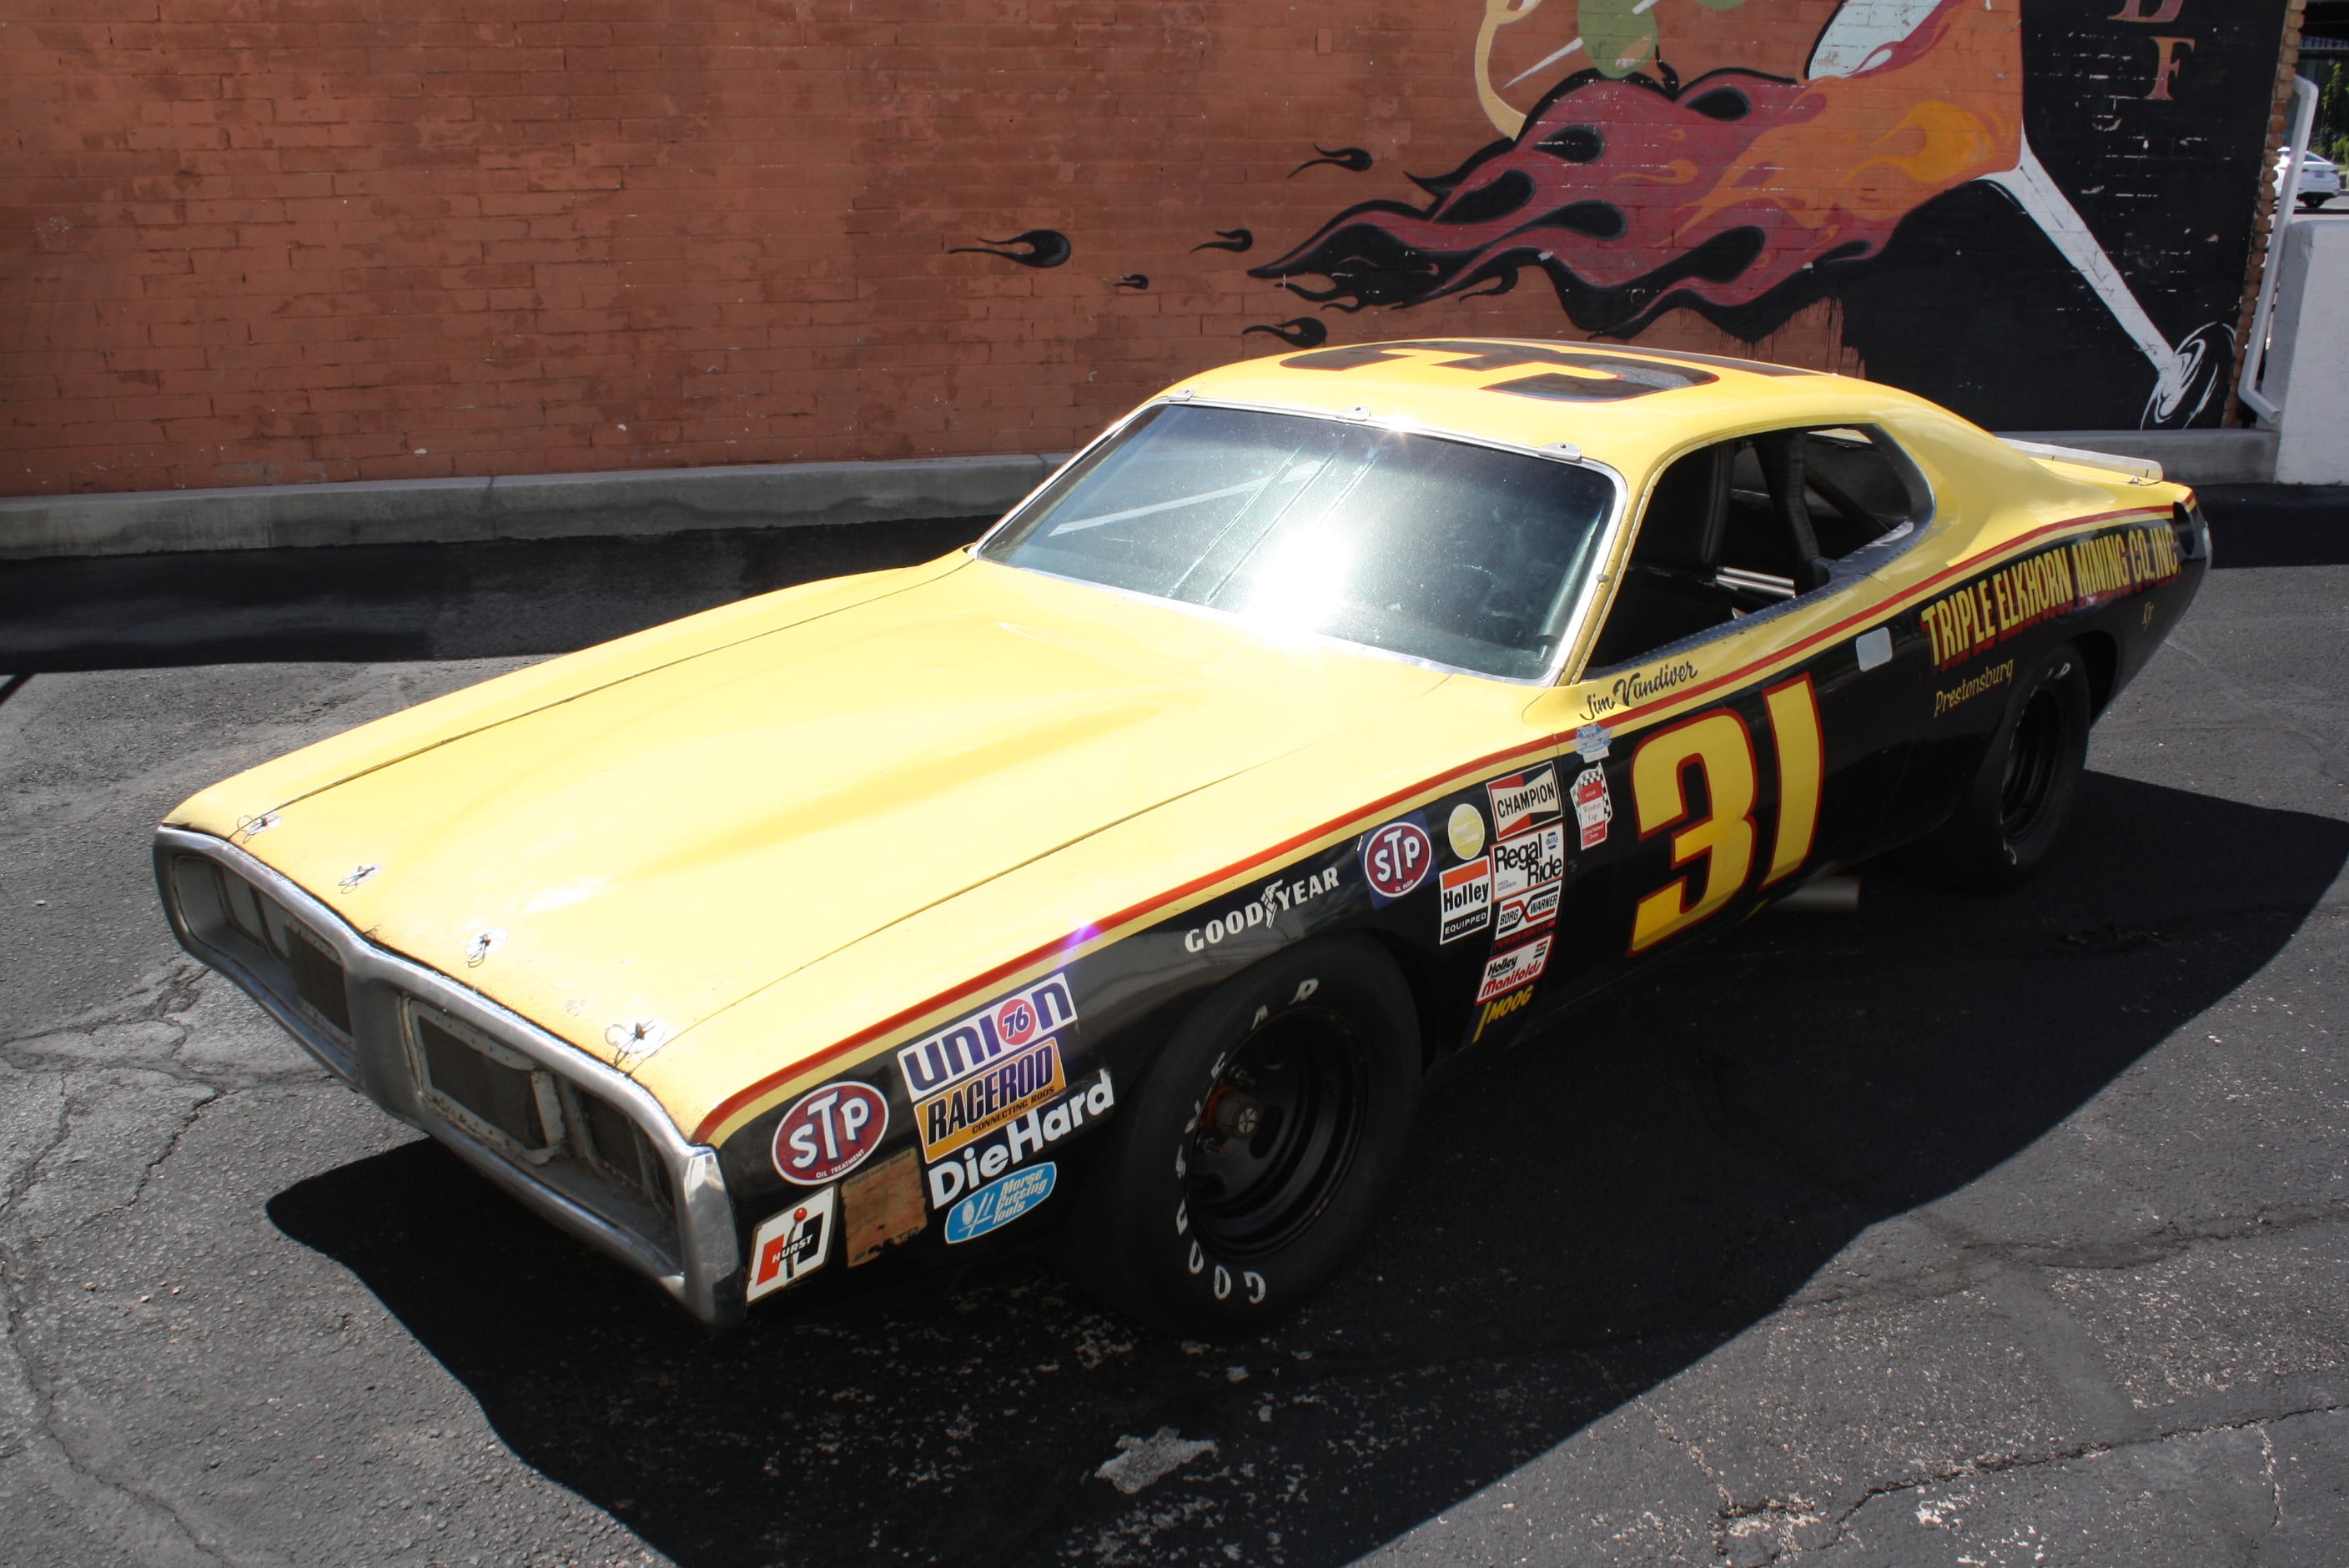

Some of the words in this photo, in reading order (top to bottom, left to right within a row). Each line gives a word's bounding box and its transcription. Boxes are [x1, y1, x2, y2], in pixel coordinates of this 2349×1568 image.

[1920, 580, 1996, 666] TRIPLE
[1992, 546, 2074, 631] ELKHORN
[2071, 533, 2130, 598] MINING
[1579, 693, 1616, 721] Jim
[1612, 661, 1698, 707] Vandiver
[1934, 658, 2015, 717] Prestonsburg
[1496, 781, 1556, 819] CHAMPION
[1627, 671, 1825, 959] 31
[1374, 827, 1421, 882] STP
[1493, 832, 1543, 873] Regal
[1527, 853, 1563, 887] Ride
[1185, 867, 1340, 953] GOODYEAR
[1443, 882, 1490, 913] Holley
[1529, 893, 1558, 915] WARNER
[1444, 912, 1486, 935] EQUIPPED
[1499, 908, 1520, 927] BORG
[1481, 959, 1542, 998] Manifolds
[1487, 955, 1518, 977] Holley
[1002, 1003, 1030, 1039] 76
[1486, 984, 1534, 1024] MOOG
[903, 981, 1074, 1092] union
[926, 1043, 1055, 1148] RACEROD
[971, 1099, 1029, 1135] CONNECTING
[1030, 1085, 1055, 1104] RODS
[788, 1090, 869, 1168] STP
[928, 1068, 1115, 1210] DieHard
[815, 1171, 828, 1179] OIL
[830, 1148, 866, 1175] TREATMENT
[1001, 1168, 1046, 1197] Morse
[992, 1199, 1026, 1225] Tools
[998, 1178, 1049, 1209] Cutting
[772, 1234, 814, 1264] HURST
